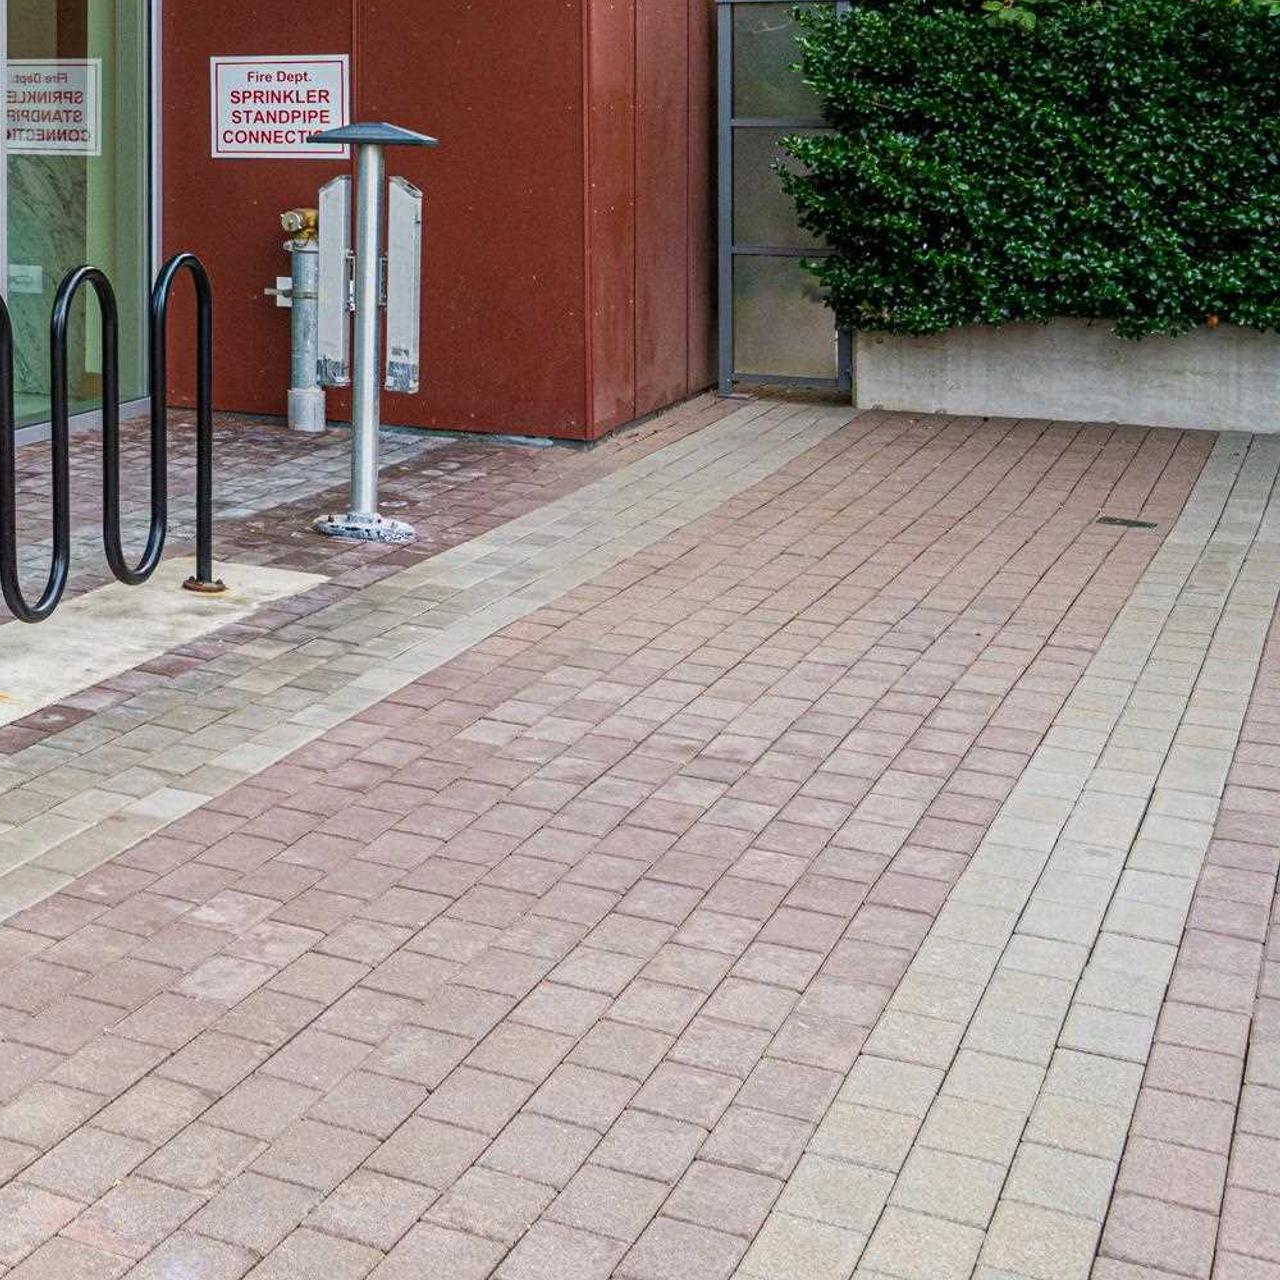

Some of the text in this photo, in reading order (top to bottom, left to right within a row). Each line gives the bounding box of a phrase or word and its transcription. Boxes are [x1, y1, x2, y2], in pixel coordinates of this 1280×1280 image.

[247, 71, 312, 84] Fire Dept.
[230, 90, 330, 104] SPRINKLER
[231, 110, 330, 124] STANDPIPE
